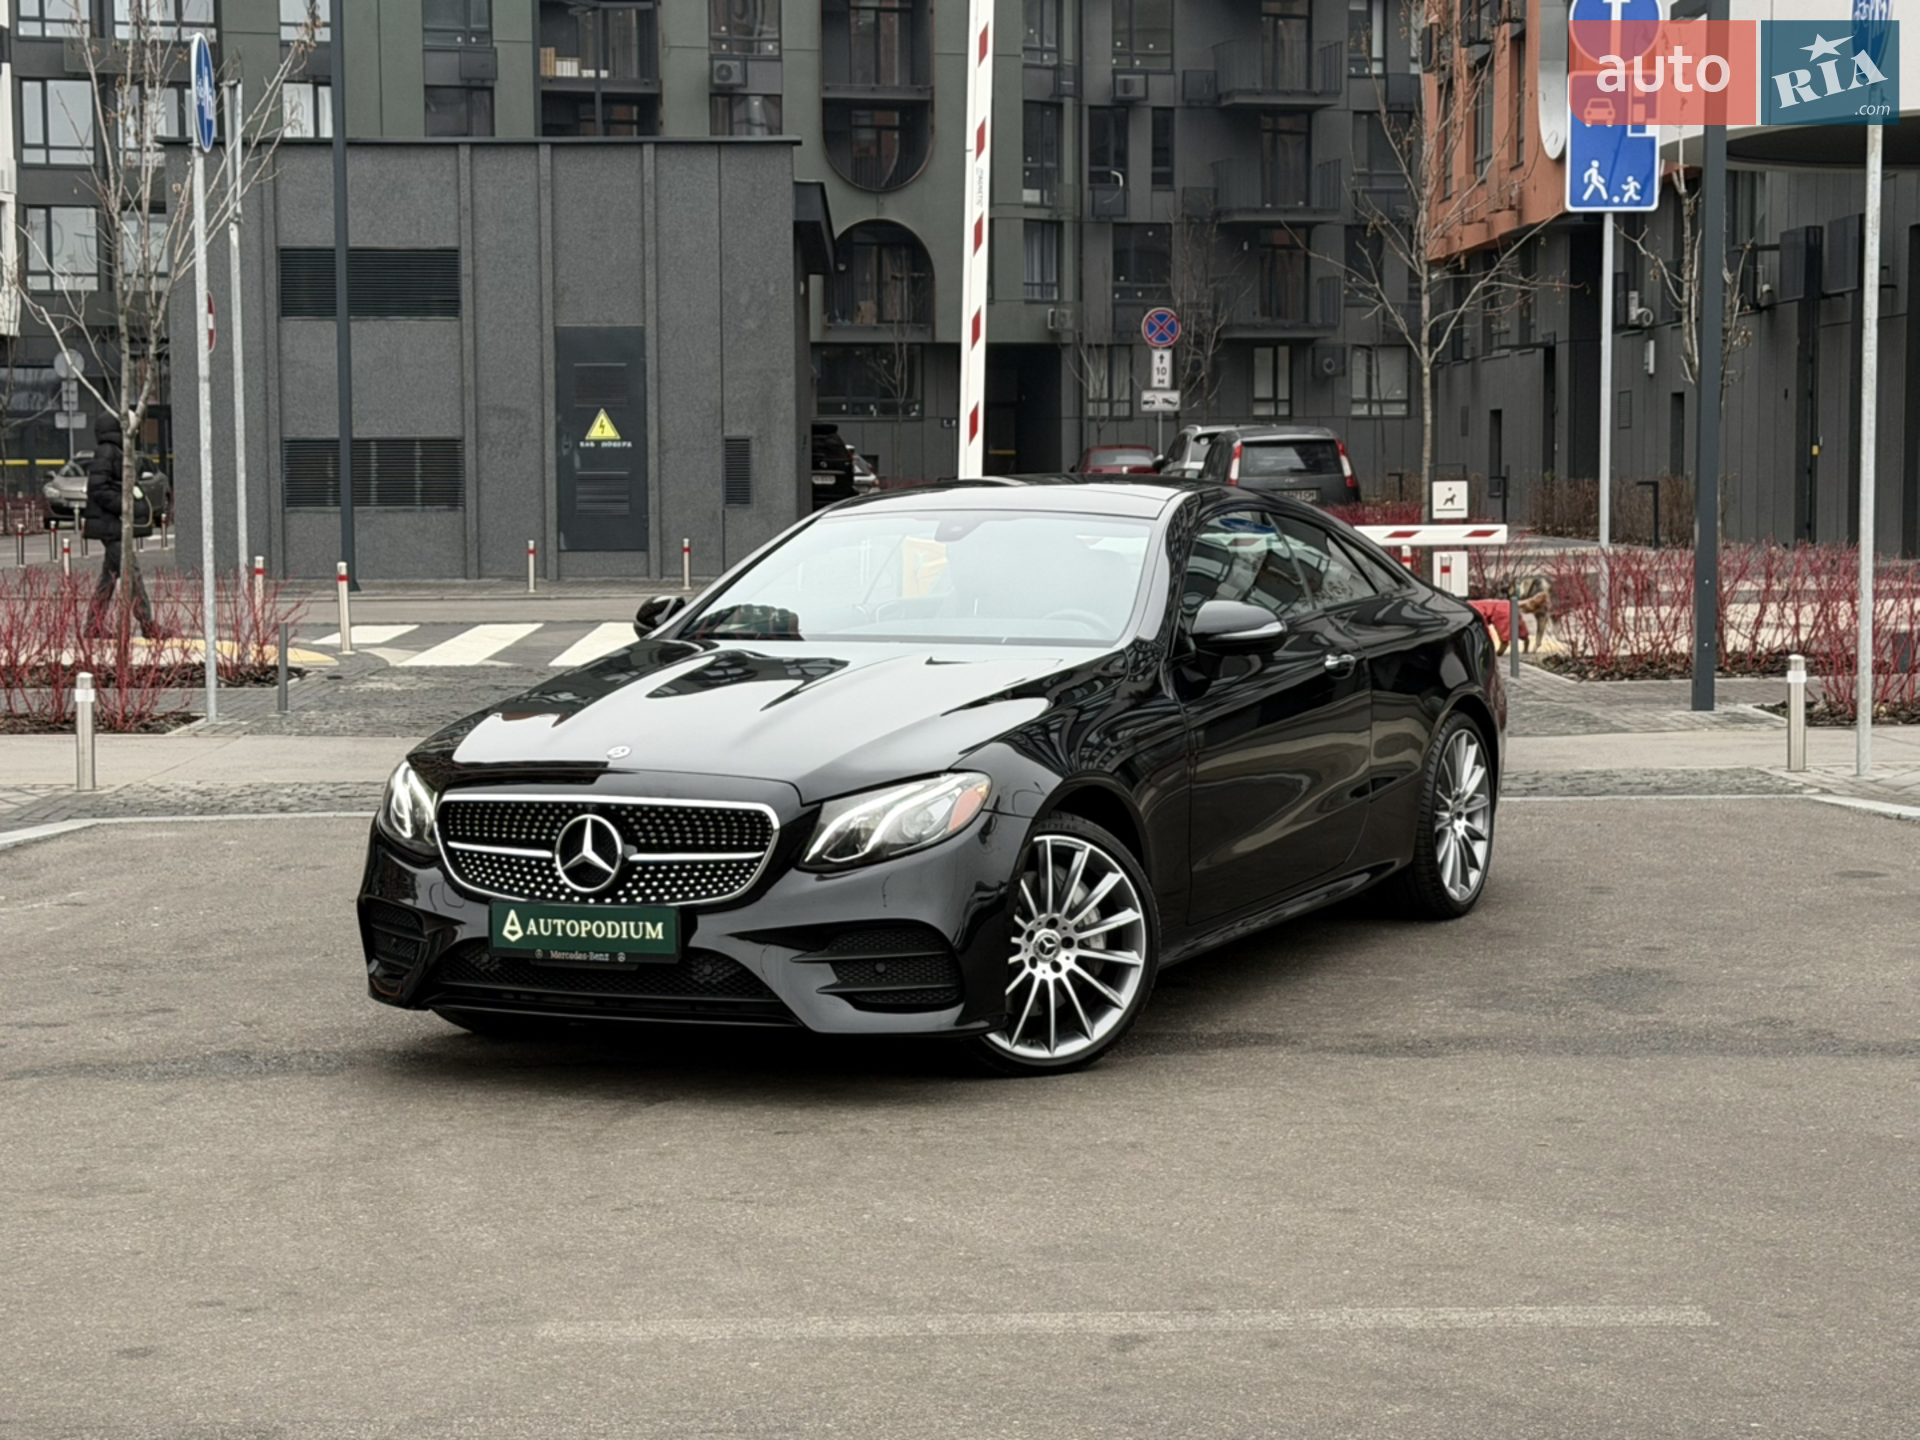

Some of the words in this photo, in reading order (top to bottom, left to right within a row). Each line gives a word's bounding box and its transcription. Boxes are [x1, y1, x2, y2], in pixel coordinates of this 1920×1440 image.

[1156, 366, 1167, 376] 10
[526, 918, 665, 940] AUTOPODIUM
[550, 950, 610, 962] Mercedes-Benz
